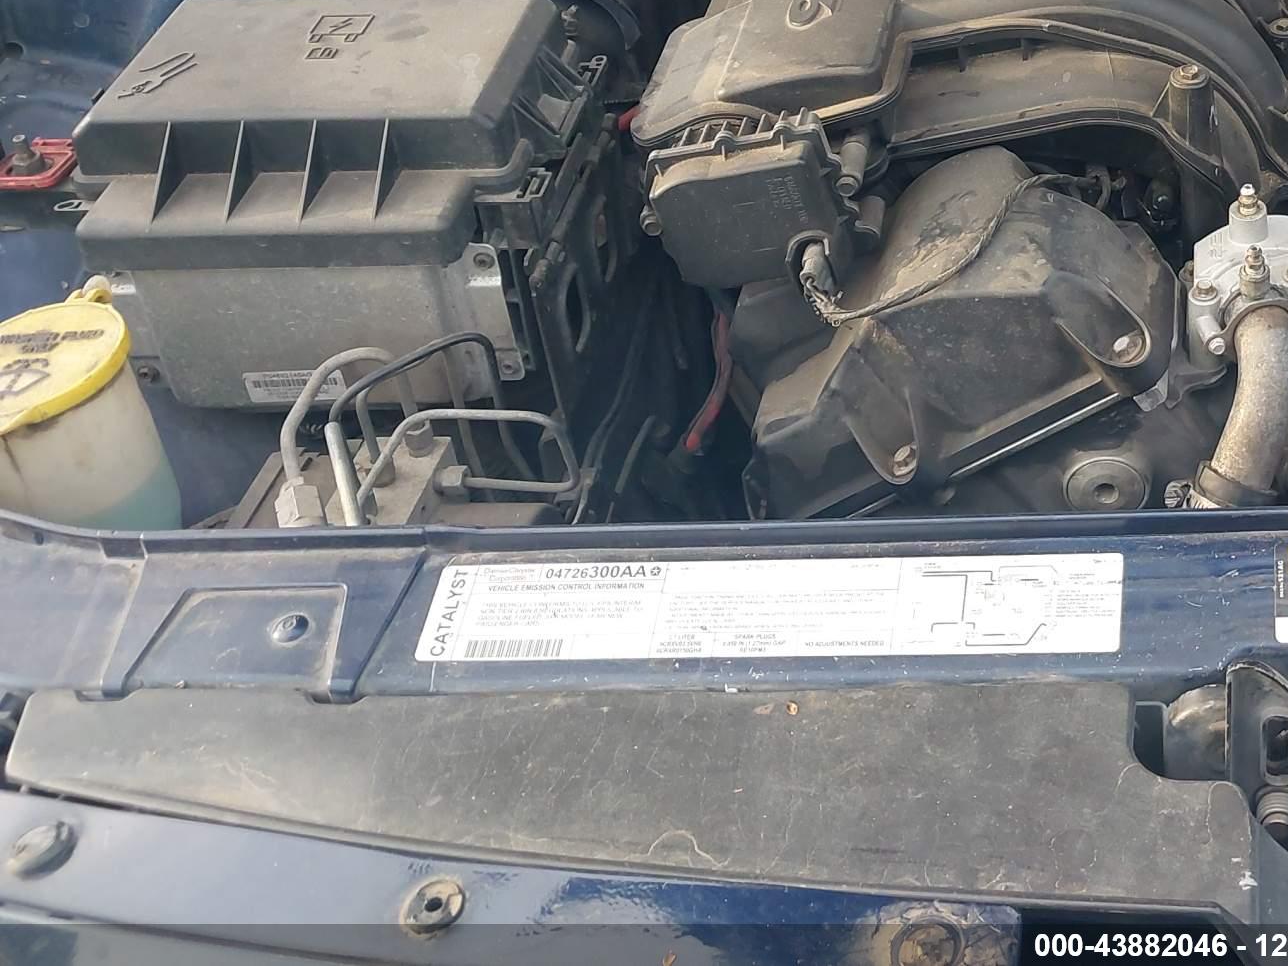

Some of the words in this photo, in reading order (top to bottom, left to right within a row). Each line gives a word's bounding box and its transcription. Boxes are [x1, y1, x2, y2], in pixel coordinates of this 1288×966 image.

[545, 565, 647, 579] 04726300AA
[594, 582, 645, 590] INFORMATION
[430, 569, 469, 657] CATALYST
